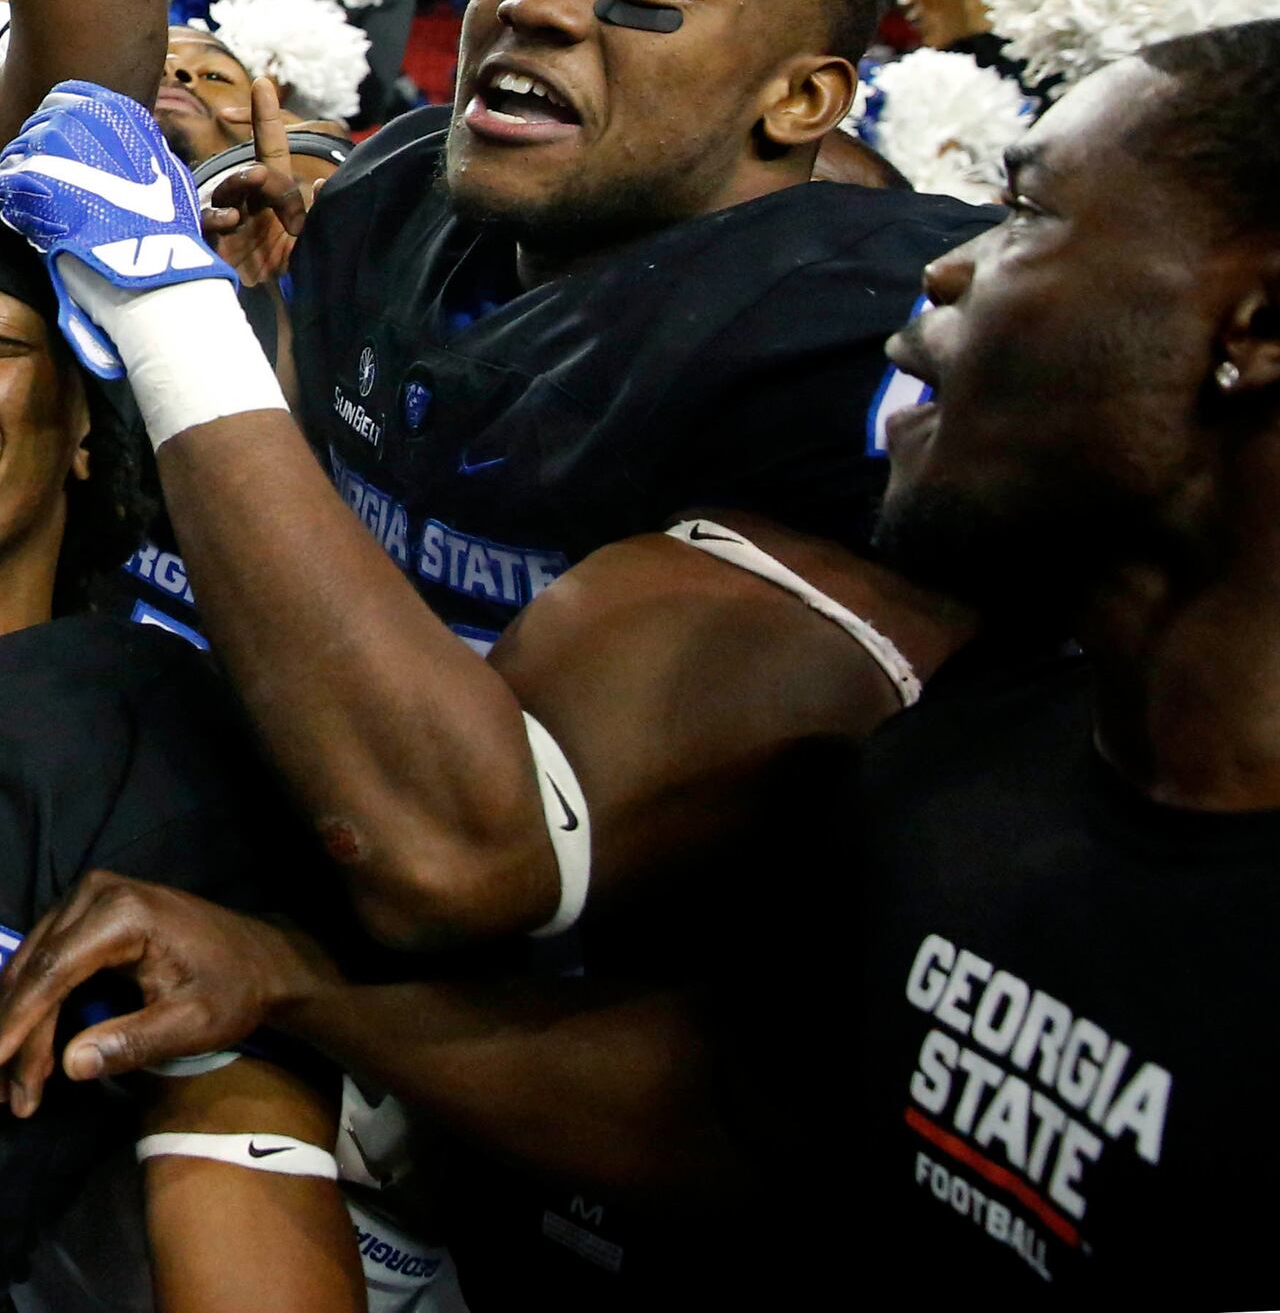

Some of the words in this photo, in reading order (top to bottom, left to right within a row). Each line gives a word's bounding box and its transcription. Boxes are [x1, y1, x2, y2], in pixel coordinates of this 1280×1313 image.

[418, 518, 568, 608] STATE
[903, 932, 1174, 1167] GEORGIA
[907, 1028, 1104, 1221] STATE
[915, 1149, 1053, 1284] FOOTBALL
